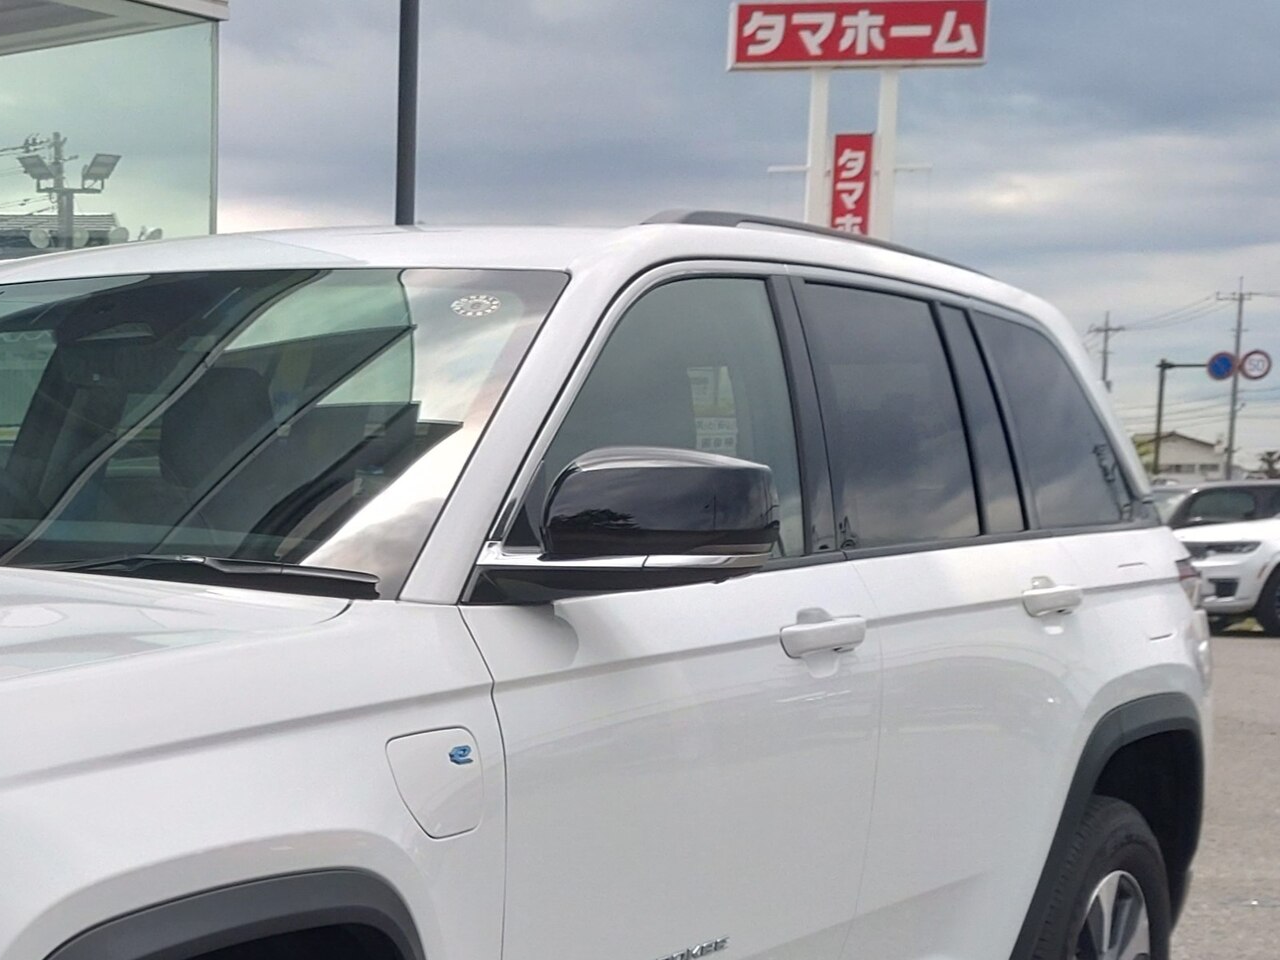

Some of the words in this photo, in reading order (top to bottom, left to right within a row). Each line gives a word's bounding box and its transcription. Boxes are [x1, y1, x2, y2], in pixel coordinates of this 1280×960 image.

[742, 9, 978, 56] タマホーム
